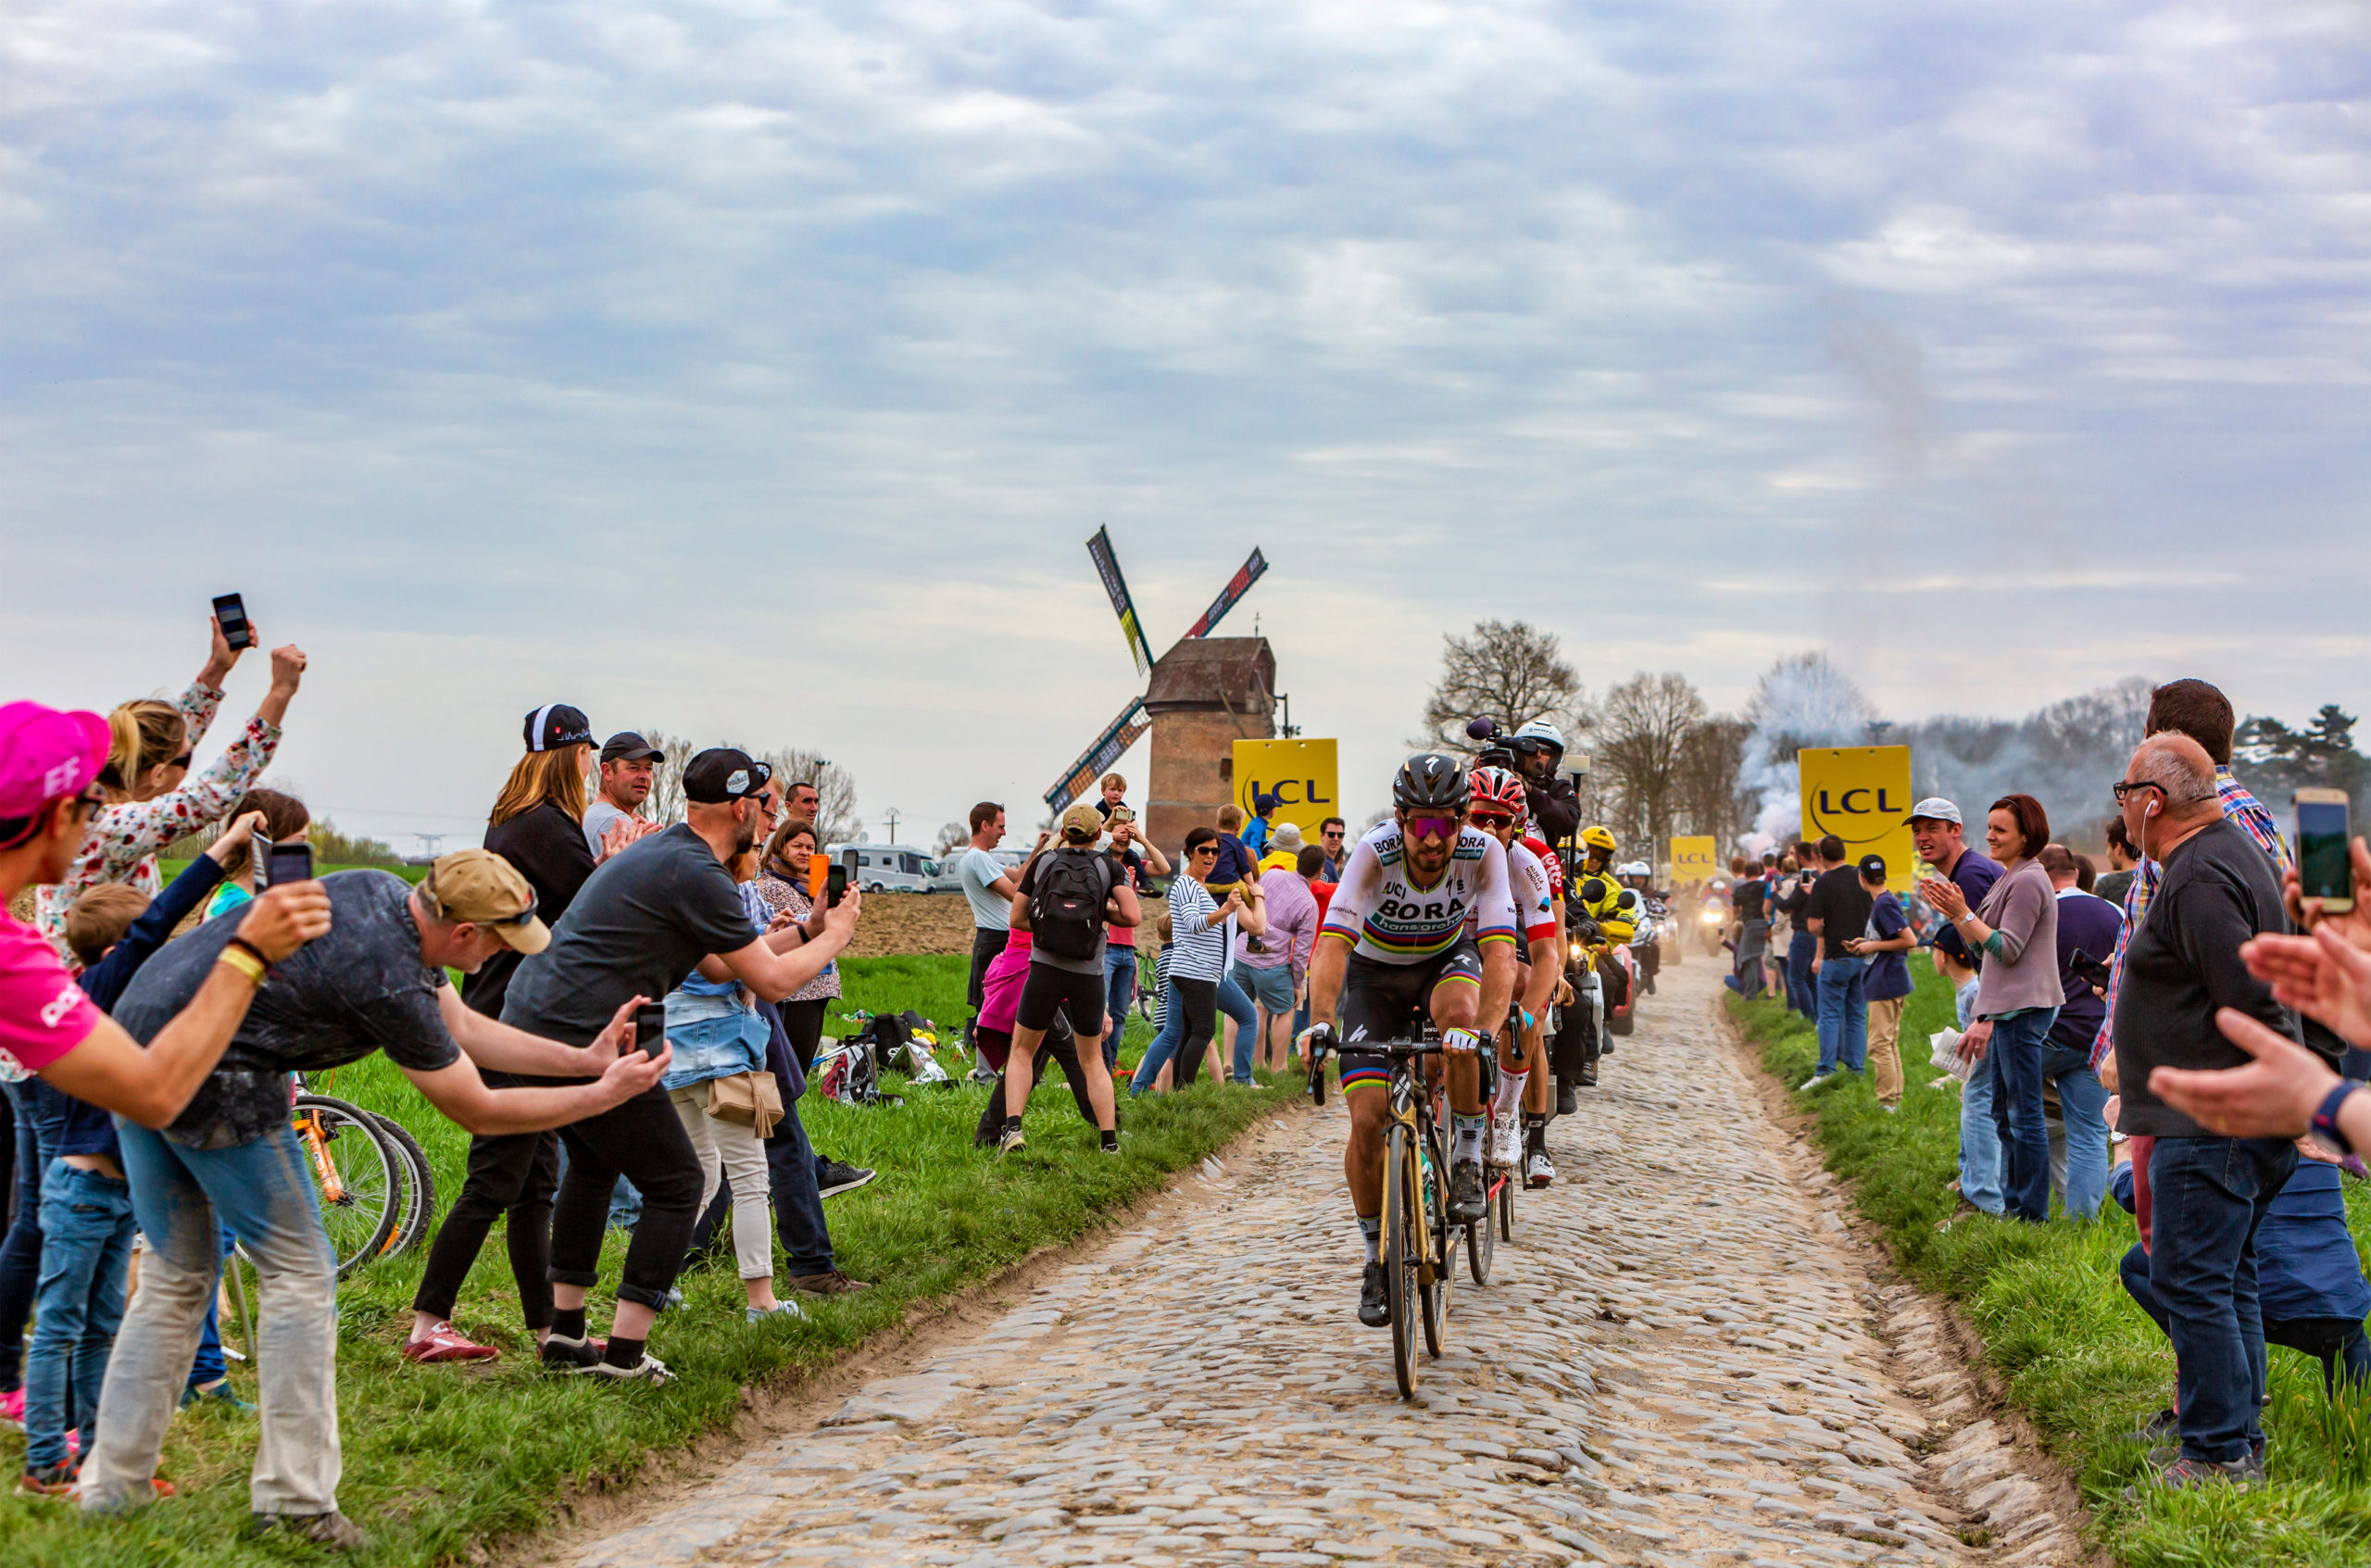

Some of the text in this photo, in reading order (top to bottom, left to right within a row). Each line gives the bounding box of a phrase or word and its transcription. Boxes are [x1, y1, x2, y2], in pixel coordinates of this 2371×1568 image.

[1251, 779, 1330, 805] LCL
[1820, 788, 1902, 814] LCL
[1459, 836, 1486, 847] ORA
[1541, 851, 1562, 888] lotto
[1678, 852, 1712, 864] LCL
[1386, 881, 1407, 900] UCI
[1524, 867, 1543, 893] MONDIALE
[1378, 898, 1465, 920] BORA
